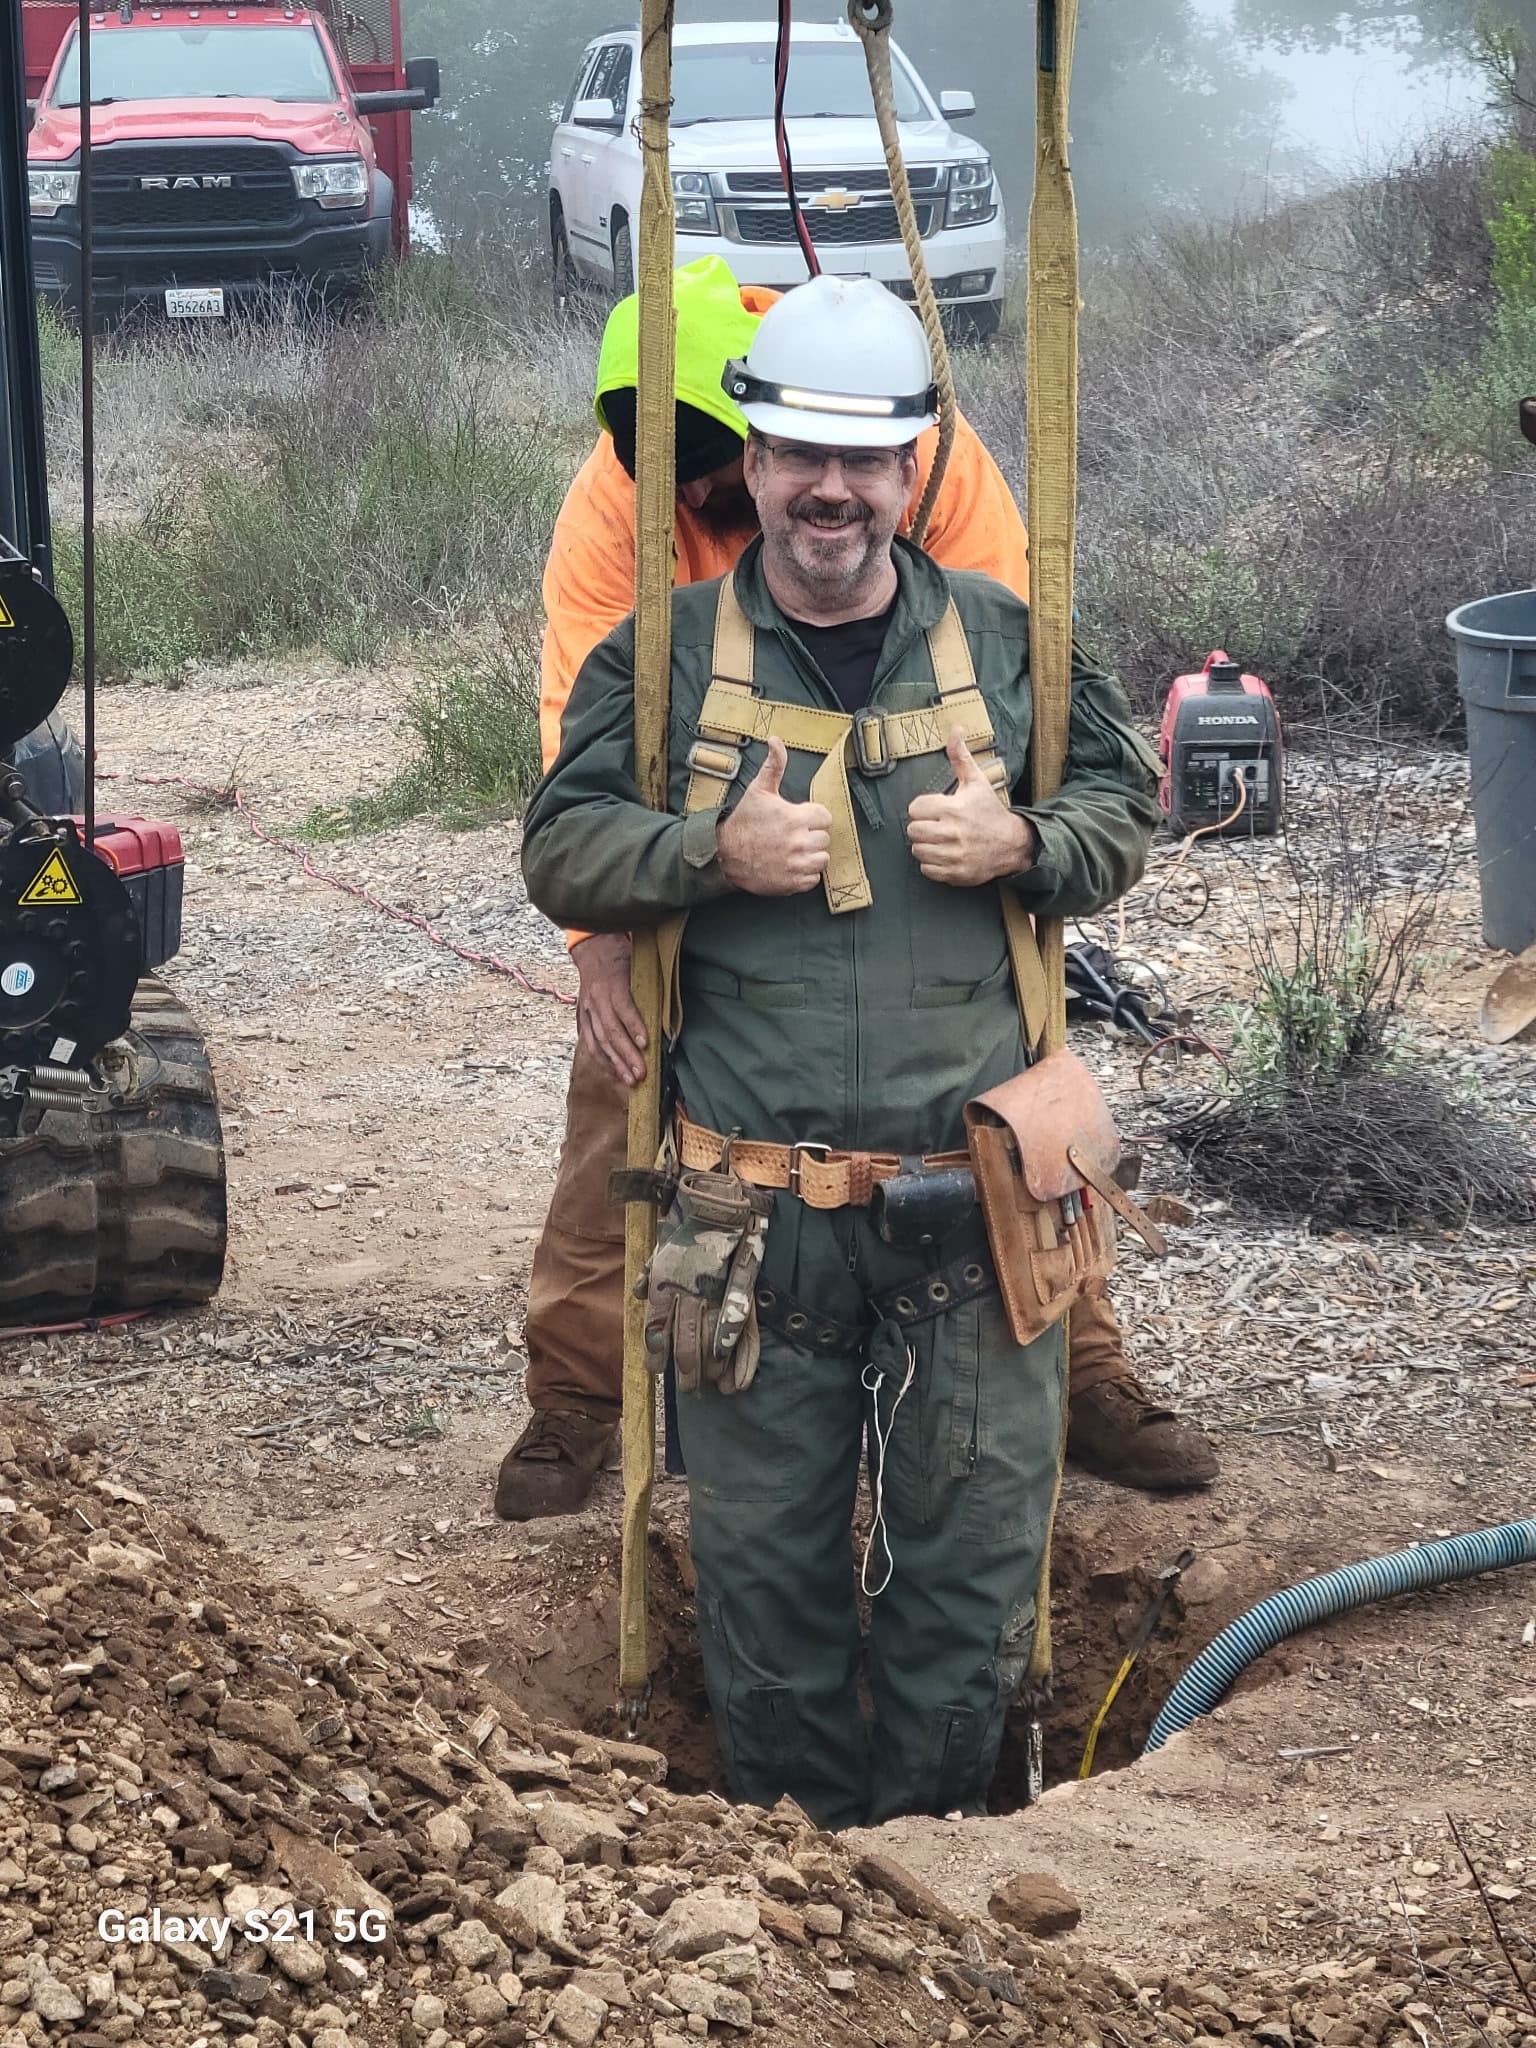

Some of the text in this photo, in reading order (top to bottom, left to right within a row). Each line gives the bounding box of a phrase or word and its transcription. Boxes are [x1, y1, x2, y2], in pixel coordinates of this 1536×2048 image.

[141, 176, 231, 190] RAM
[170, 299, 220, 314] 35626A3
[1198, 715, 1260, 725] HONDA
